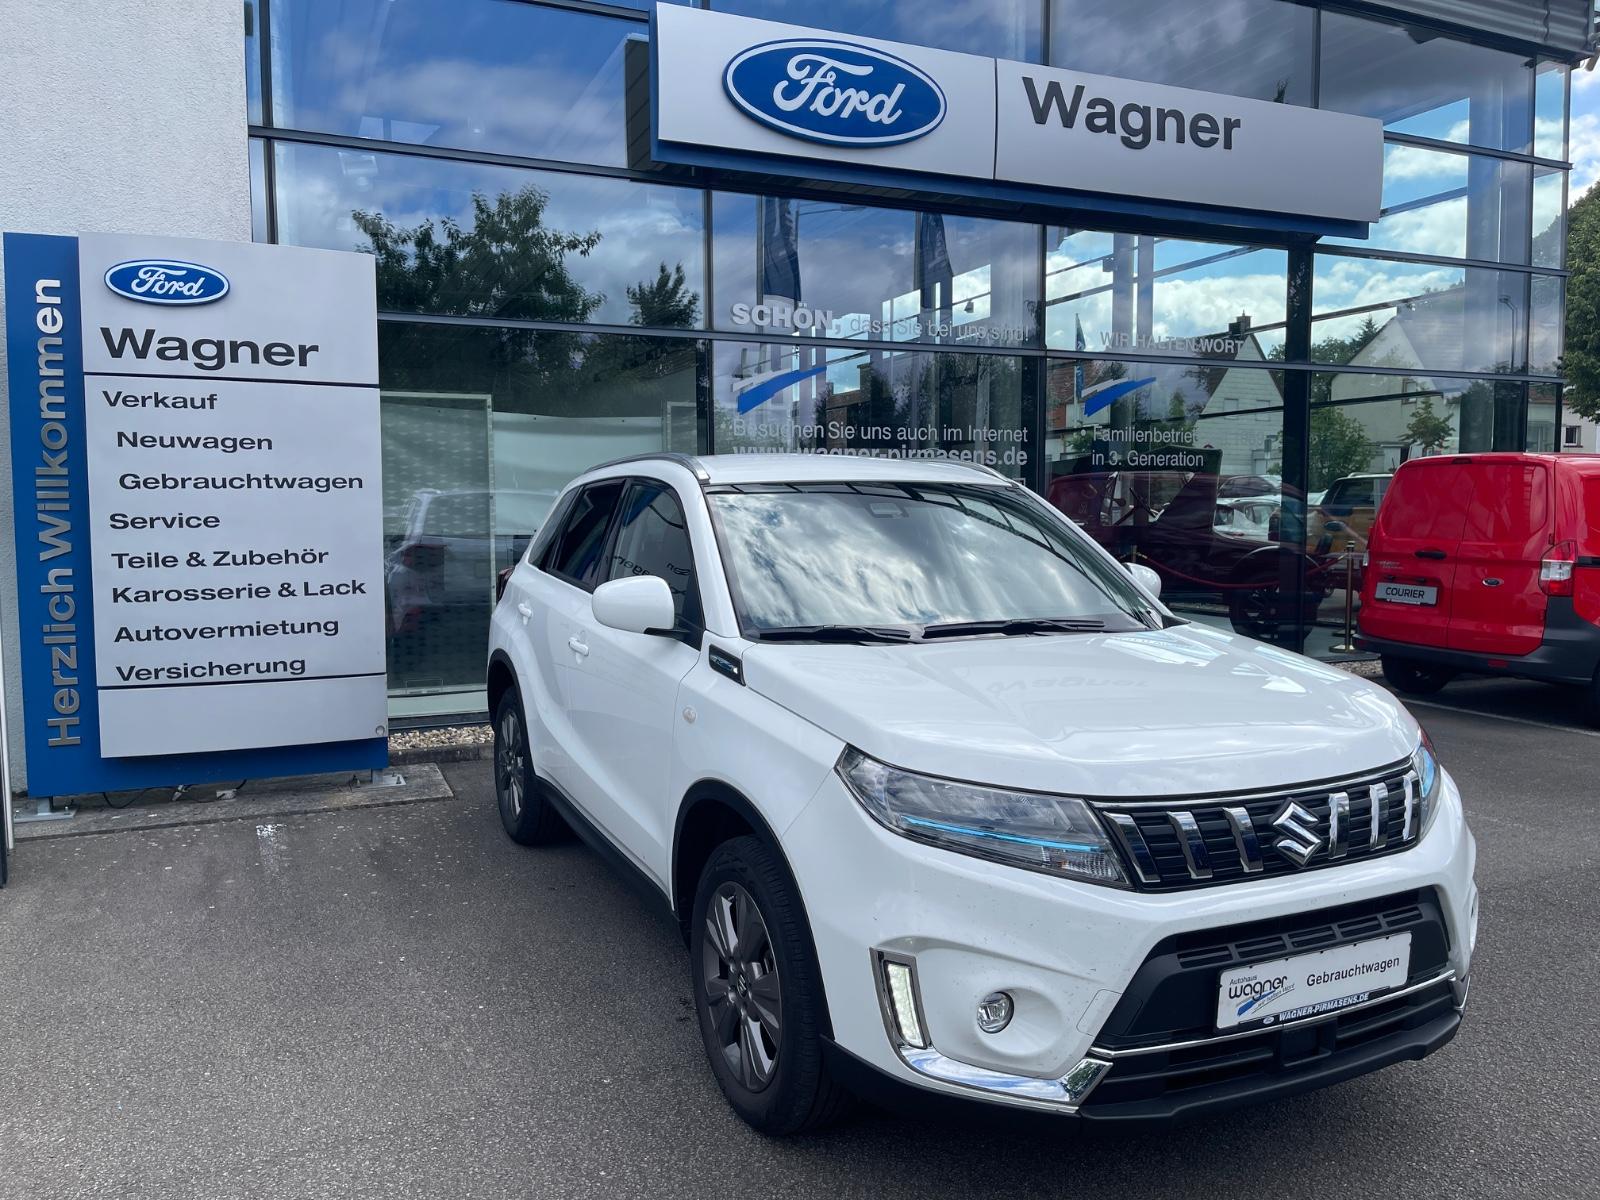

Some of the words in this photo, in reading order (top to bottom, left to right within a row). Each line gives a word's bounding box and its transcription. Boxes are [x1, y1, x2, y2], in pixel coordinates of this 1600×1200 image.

[772, 52, 907, 127] Ford
[1022, 76, 1242, 150] Wagner
[131, 265, 206, 298] Ford
[730, 301, 841, 334] SCHÖN,
[896, 319, 923, 336] Sie
[928, 320, 952, 338] bei
[100, 326, 319, 371] Wagner
[1100, 331, 1129, 349] WIR
[1136, 333, 1197, 353] HALTEN
[1200, 337, 1245, 355] WORT
[102, 390, 218, 411] Verkauf
[35, 278, 73, 562] Willkommen
[733, 419, 825, 439] Besuchen
[828, 421, 855, 440] Sie
[861, 426, 891, 441] uns
[897, 423, 938, 441] auch
[943, 425, 962, 442] im
[968, 425, 1028, 443] Internet
[117, 431, 273, 454] Neuwagen
[732, 444, 1029, 466] wwwwaner-pirmasens.de
[1092, 450, 1104, 466] in
[1109, 452, 1122, 466] 3.
[1127, 450, 1204, 468] Generation
[119, 473, 363, 493] Gebrauchtwagen
[109, 512, 221, 530] Service
[111, 552, 179, 569] Teile
[186, 551, 206, 568] &
[213, 547, 329, 567] Zubehör
[112, 582, 271, 603] Karosserie
[278, 582, 297, 598] &
[303, 579, 366, 598] Lack
[1384, 586, 1425, 599] COURIER
[114, 618, 340, 643] Autovermietung
[40, 567, 81, 748] Herzlich
[116, 657, 306, 681] Versicherung
[1229, 974, 1257, 986] Autohaus
[1306, 957, 1400, 987] Gebrauchtwagen
[1228, 975, 1288, 1002] wagner
